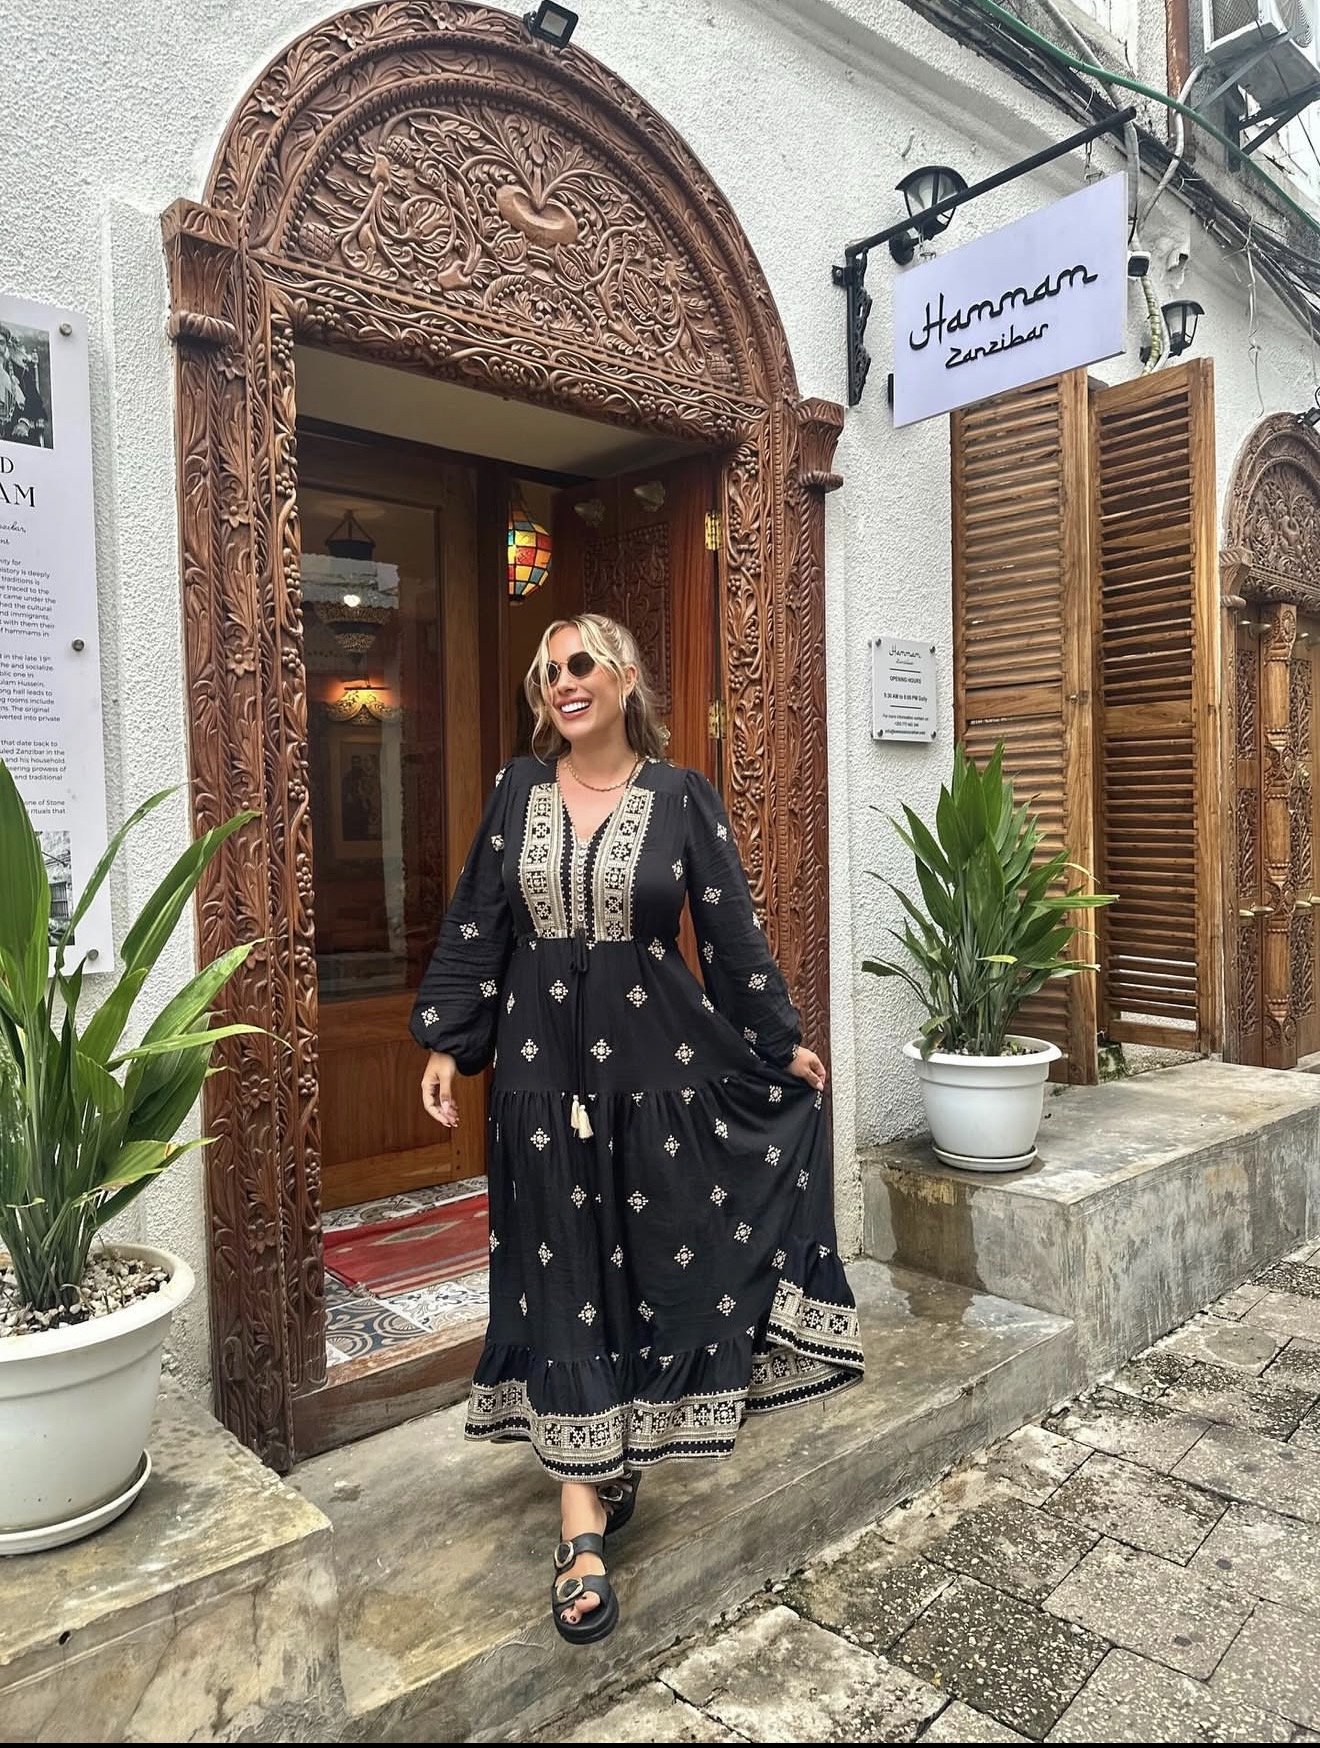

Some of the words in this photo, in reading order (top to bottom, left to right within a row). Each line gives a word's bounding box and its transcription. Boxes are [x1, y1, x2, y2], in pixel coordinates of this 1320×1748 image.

[909, 264, 1098, 350] Hammam
[945, 324, 1048, 369] Zanzibar
[28, 570, 50, 578] deeply
[1, 576, 33, 585] traditions
[7, 585, 28, 593] traced
[24, 595, 43, 603] under
[27, 604, 52, 612] cultural
[20, 620, 38, 628] them
[5, 628, 41, 636] hammams
[889, 675, 907, 684] OPENING
[907, 677, 922, 685] HOURS
[25, 706, 50, 714] original
